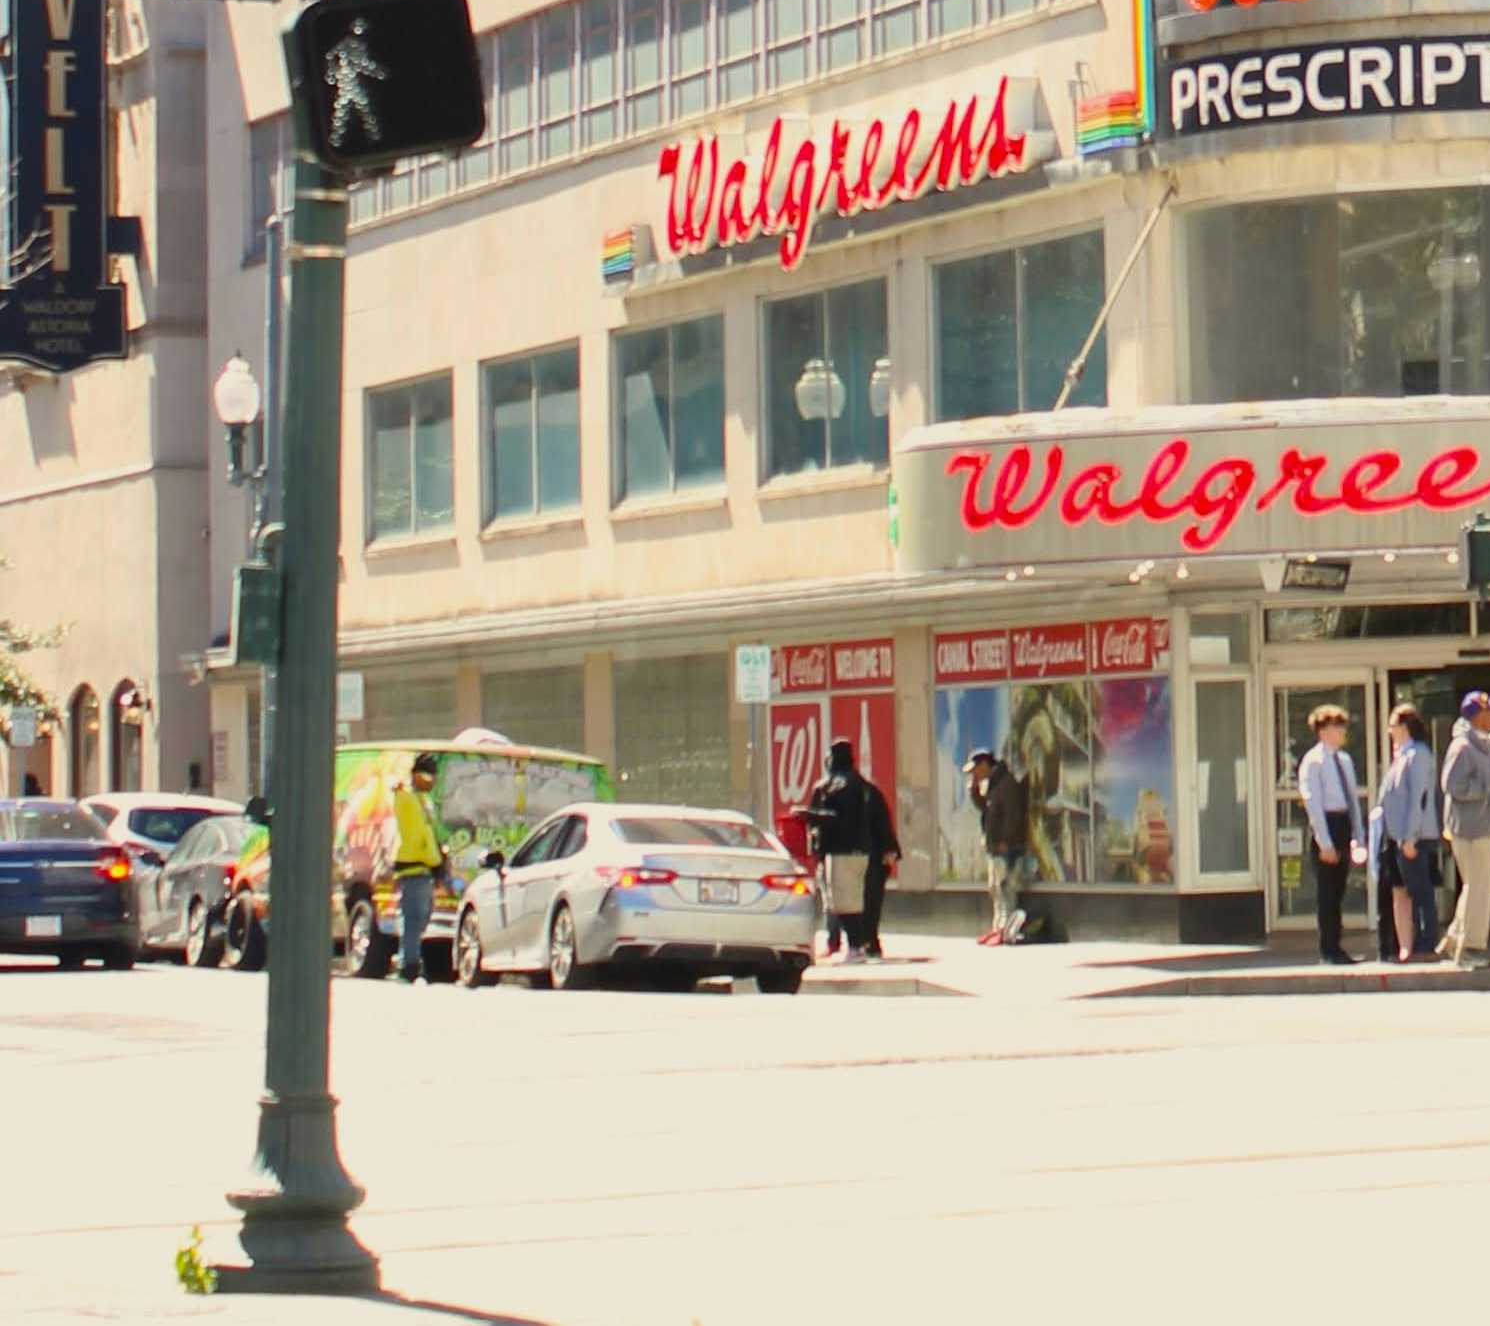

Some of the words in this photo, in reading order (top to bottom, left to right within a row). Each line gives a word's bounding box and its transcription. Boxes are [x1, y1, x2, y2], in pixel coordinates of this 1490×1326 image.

[657, 75, 1027, 272] Walgreens
[1012, 631, 1085, 677] Walgreens
[773, 716, 816, 805] W
